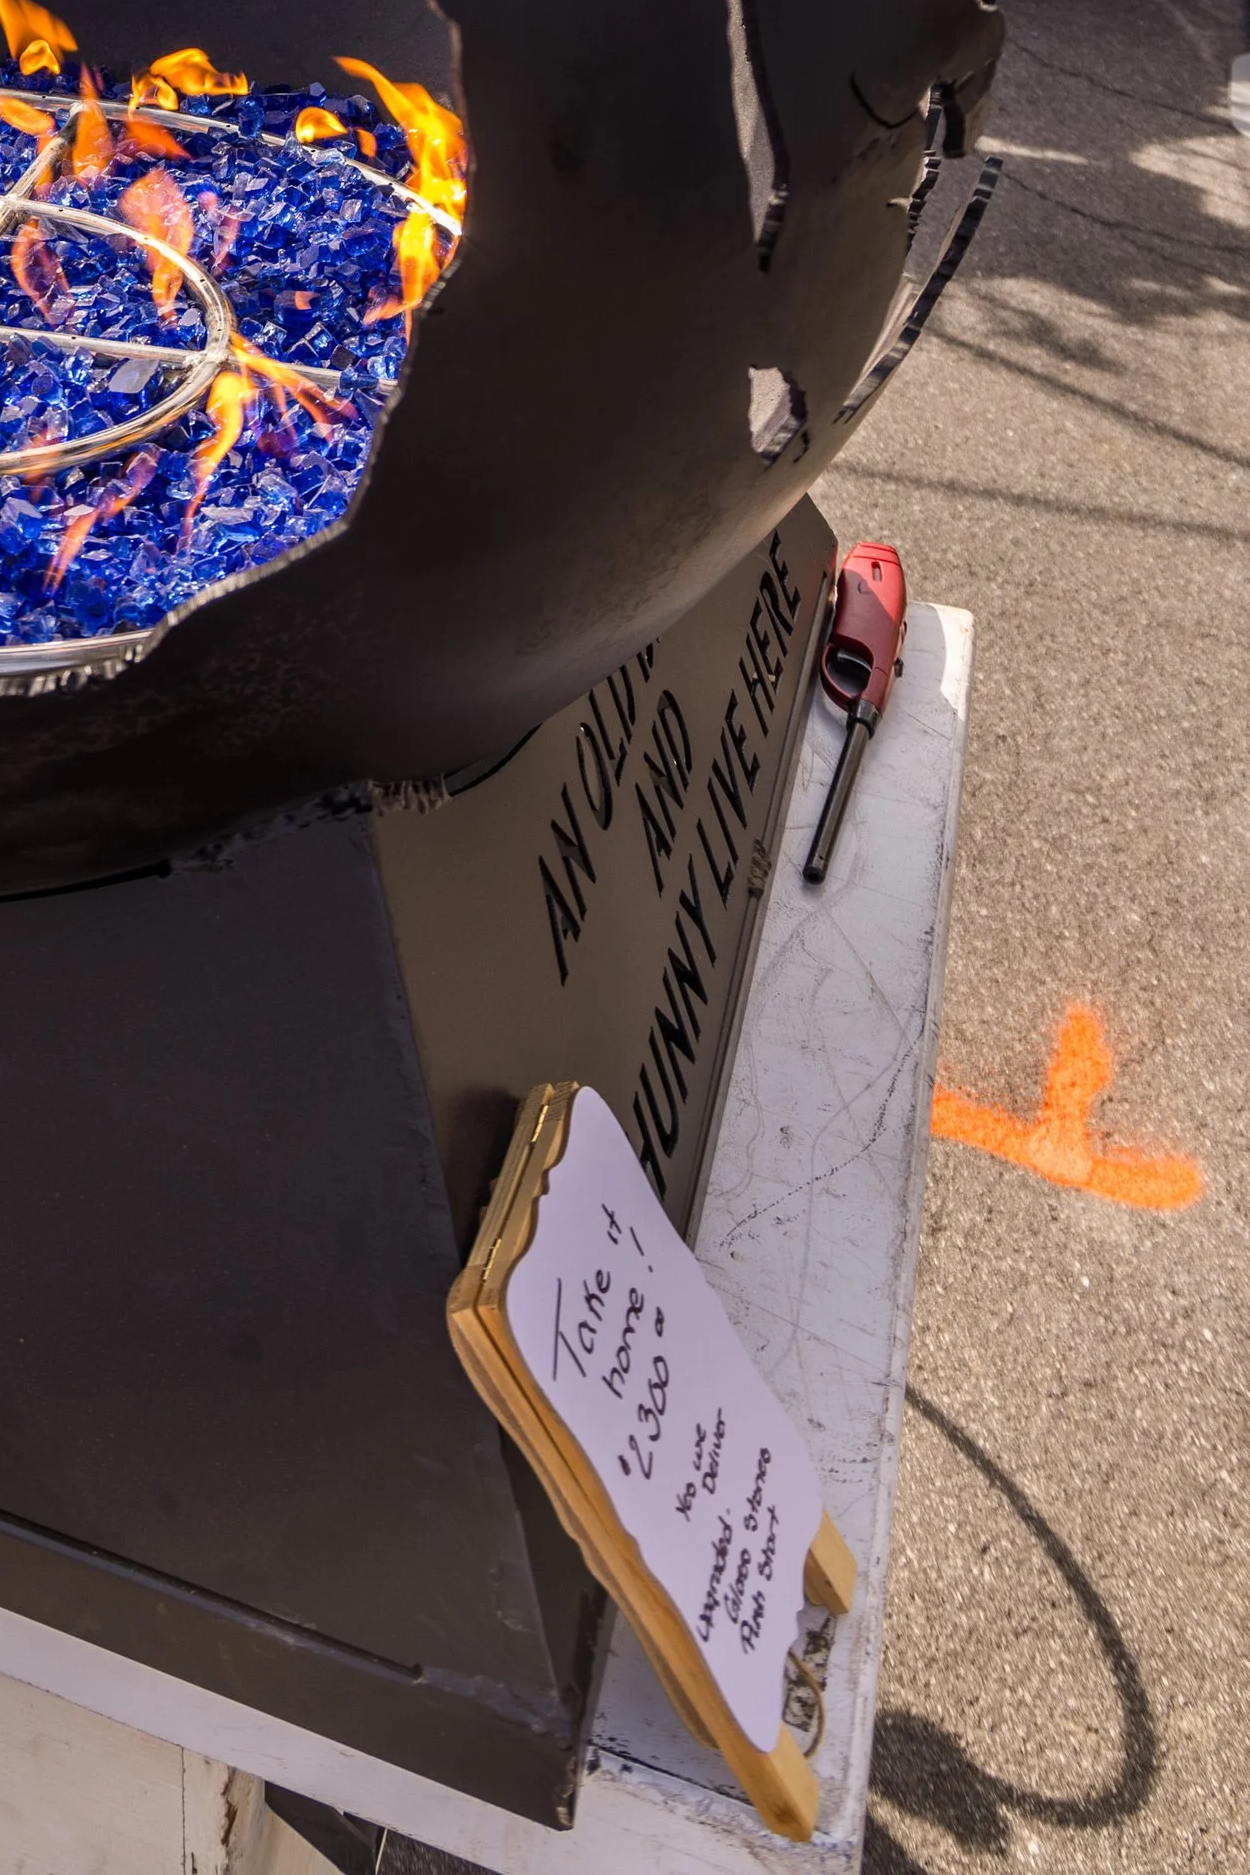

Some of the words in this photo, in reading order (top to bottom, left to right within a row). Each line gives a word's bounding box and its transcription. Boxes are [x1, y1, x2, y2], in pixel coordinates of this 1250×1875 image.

[538, 782, 597, 987] AN
[575, 662, 637, 831] OLD
[624, 854, 717, 1204] HUNNY
[696, 688, 760, 910] LIVE
[739, 528, 802, 739] HERE
[634, 689, 693, 898] AND
[553, 1269, 611, 1382] Take
[601, 1203, 622, 1245] it
[675, 1481, 697, 1522] Yes
[692, 1422, 707, 1472] we
[702, 1407, 727, 1495] Deliver
[723, 1548, 752, 1624] Glass
[743, 1447, 771, 1532] Stones
[740, 1589, 766, 1655] Push
[757, 1503, 780, 1582] Start
